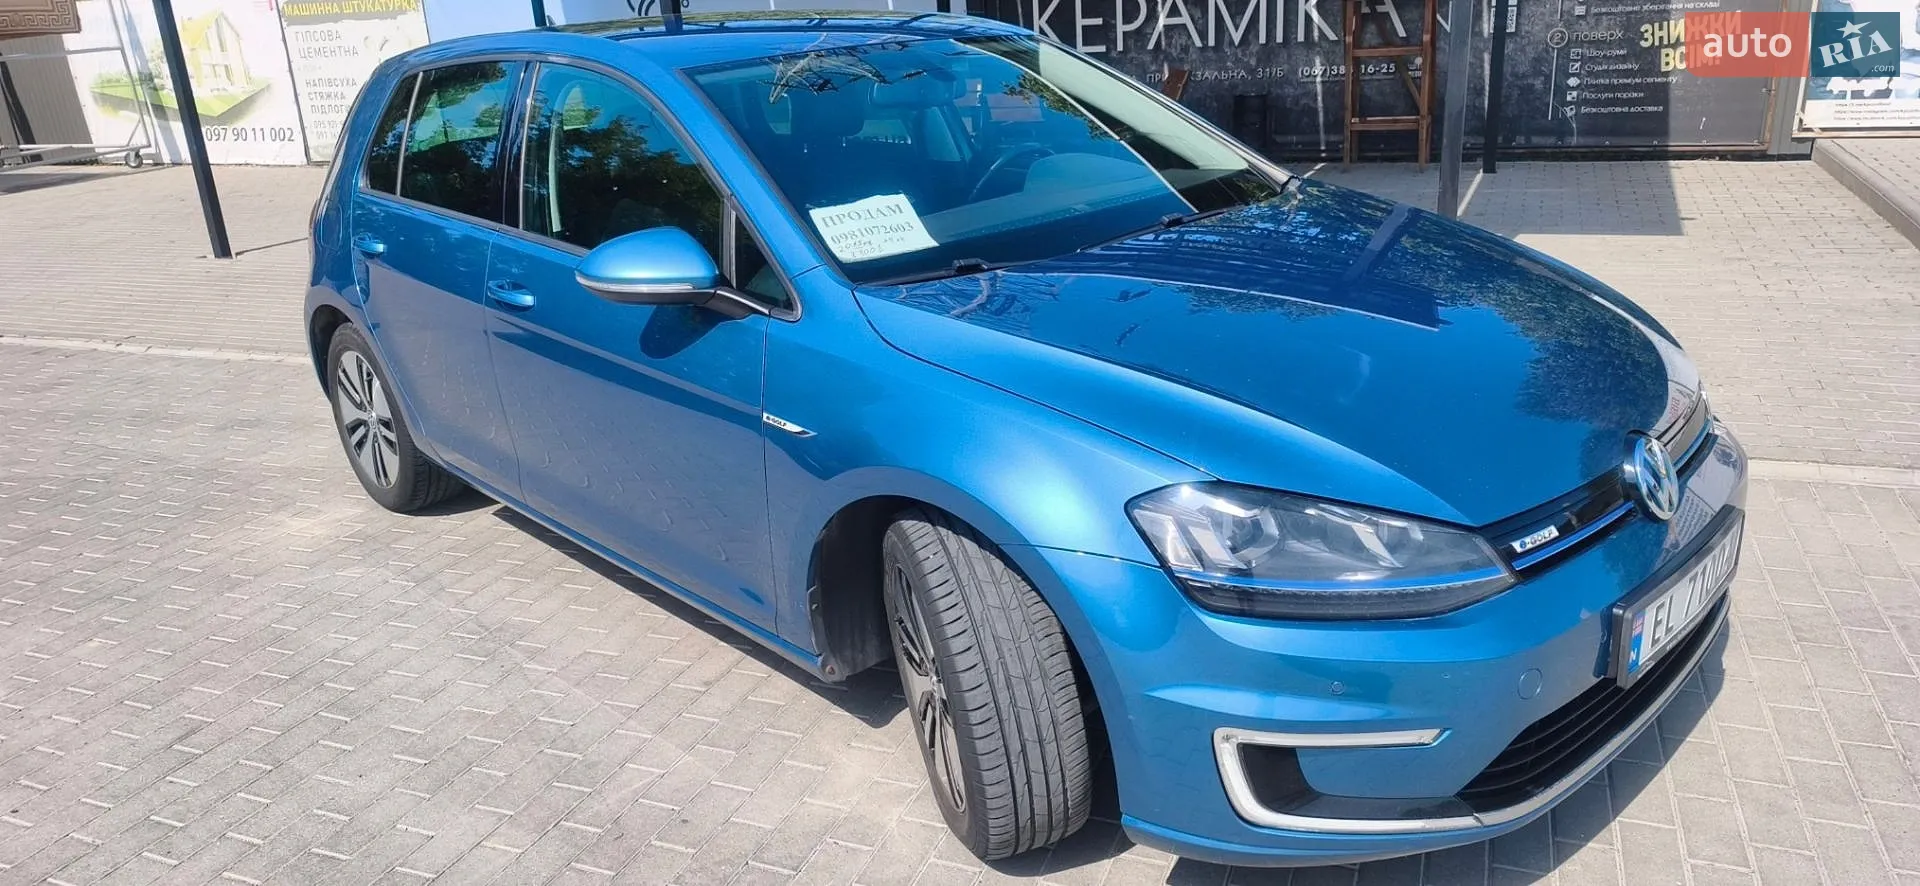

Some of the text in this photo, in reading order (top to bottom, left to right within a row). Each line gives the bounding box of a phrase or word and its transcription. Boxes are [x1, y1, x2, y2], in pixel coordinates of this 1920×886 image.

[284, 0, 417, 16] МАШИННА ШТУКАТУРКА
[1640, 10, 1741, 48] ЗНИЖКИ
[295, 30, 342, 42] ГІПСОВА
[1574, 30, 1623, 42] поверх
[298, 46, 360, 59] ЦЕМЕНТНА
[1256, 67, 1284, 79] 31/Б
[305, 78, 358, 88] НАПІВСУХА
[308, 91, 346, 101] СТЯЖКА
[205, 127, 295, 141] 097 90 11 002
[822, 204, 904, 228] ПРОДАМ
[830, 221, 914, 244] 0981072603
[1649, 594, 1675, 649] EL
